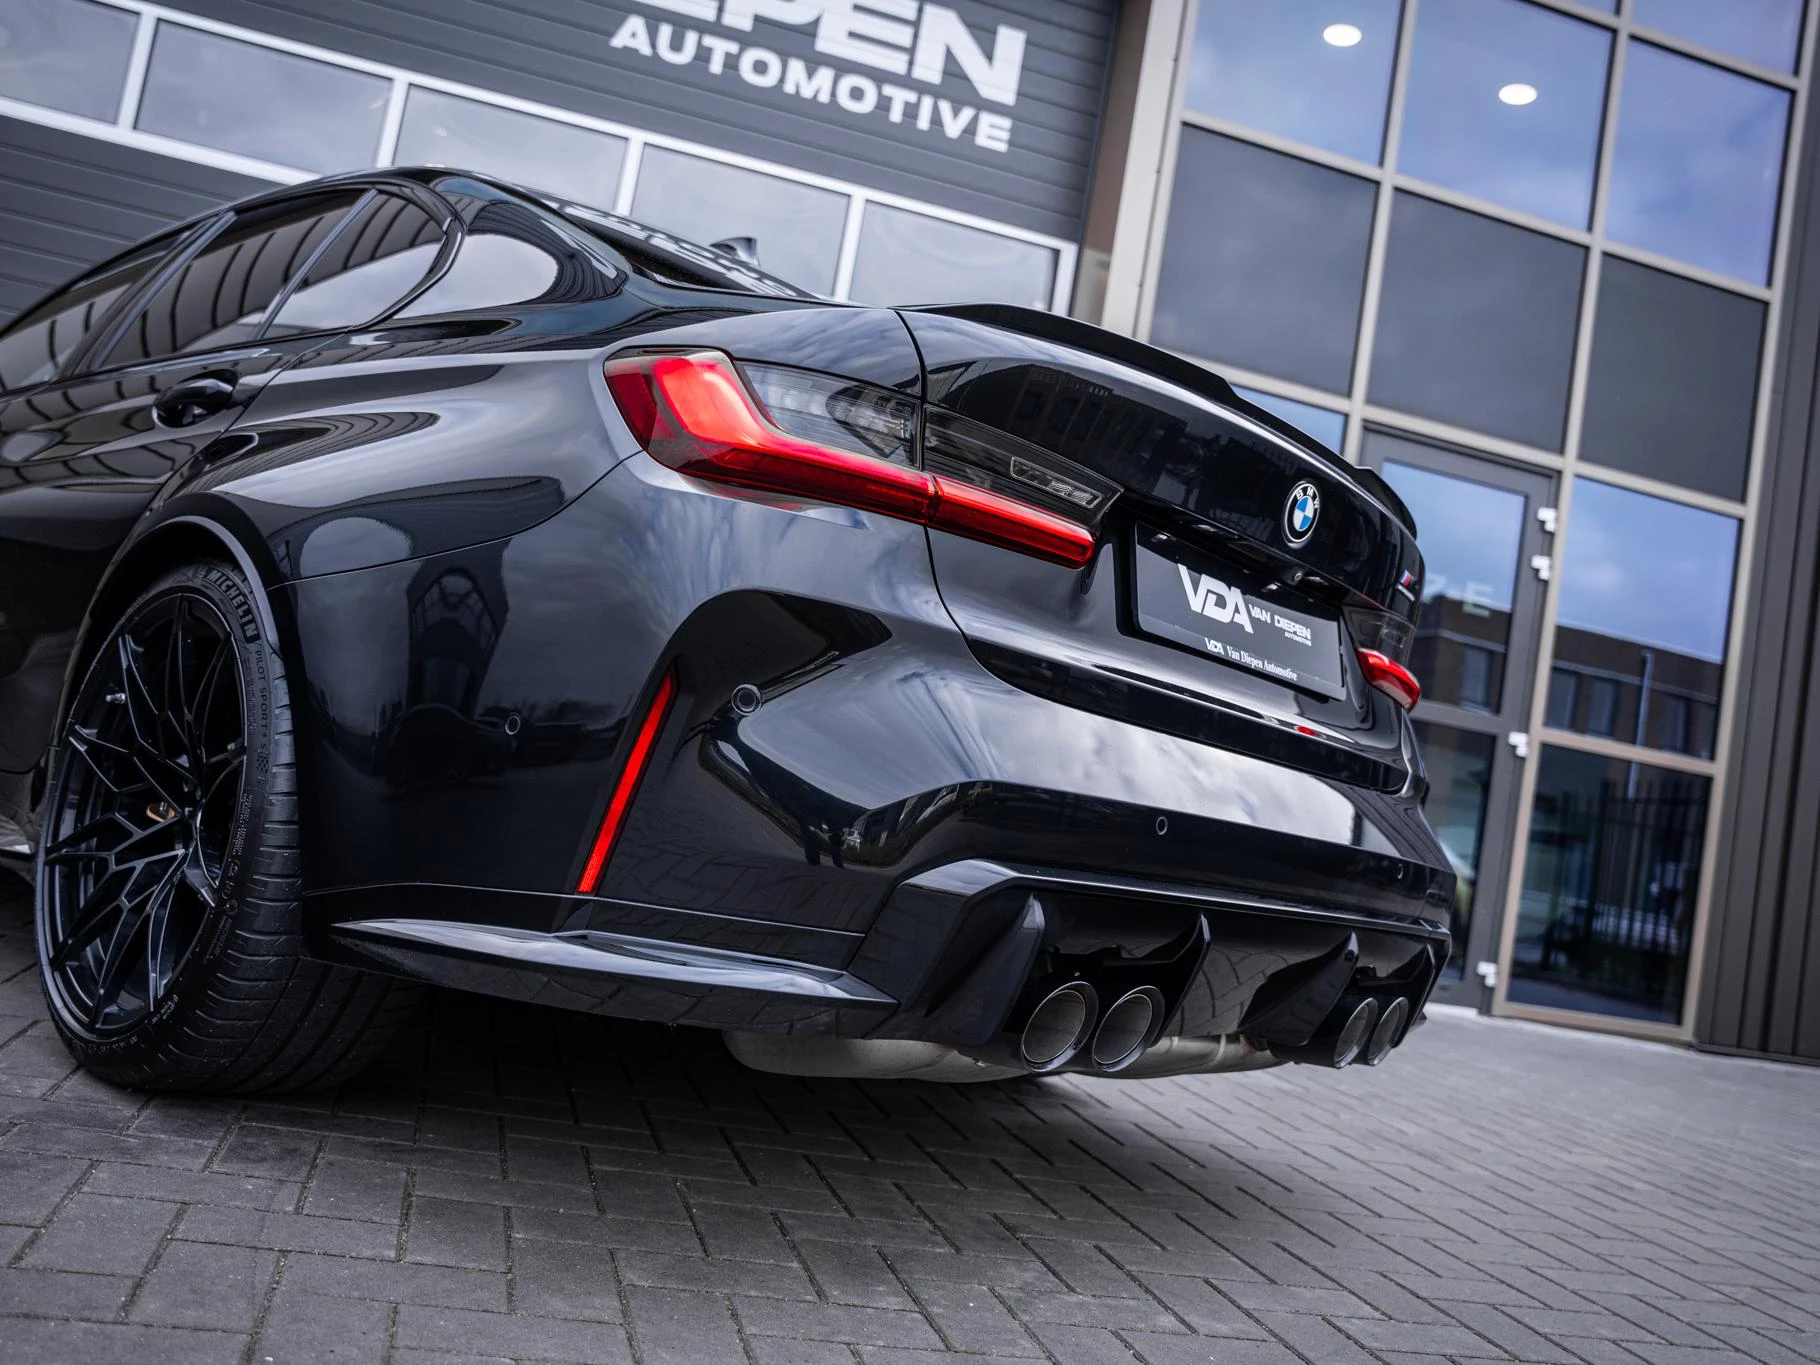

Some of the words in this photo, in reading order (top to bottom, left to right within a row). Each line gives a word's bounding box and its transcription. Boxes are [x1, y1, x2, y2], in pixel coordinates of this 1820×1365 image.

[609, 14, 1013, 153] AUTOMOTIVE
[205, 569, 259, 639] MICHELIN
[1177, 563, 1254, 633] VDA
[1248, 604, 1271, 624] VAN
[1274, 614, 1312, 640] DIEPEN
[255, 650, 266, 681] PILOT
[1204, 637, 1224, 655] VDA
[1227, 646, 1241, 661] Van
[1241, 650, 1263, 668] Diepen
[1264, 659, 1298, 681] Automotive
[259, 687, 268, 728] SPORT
